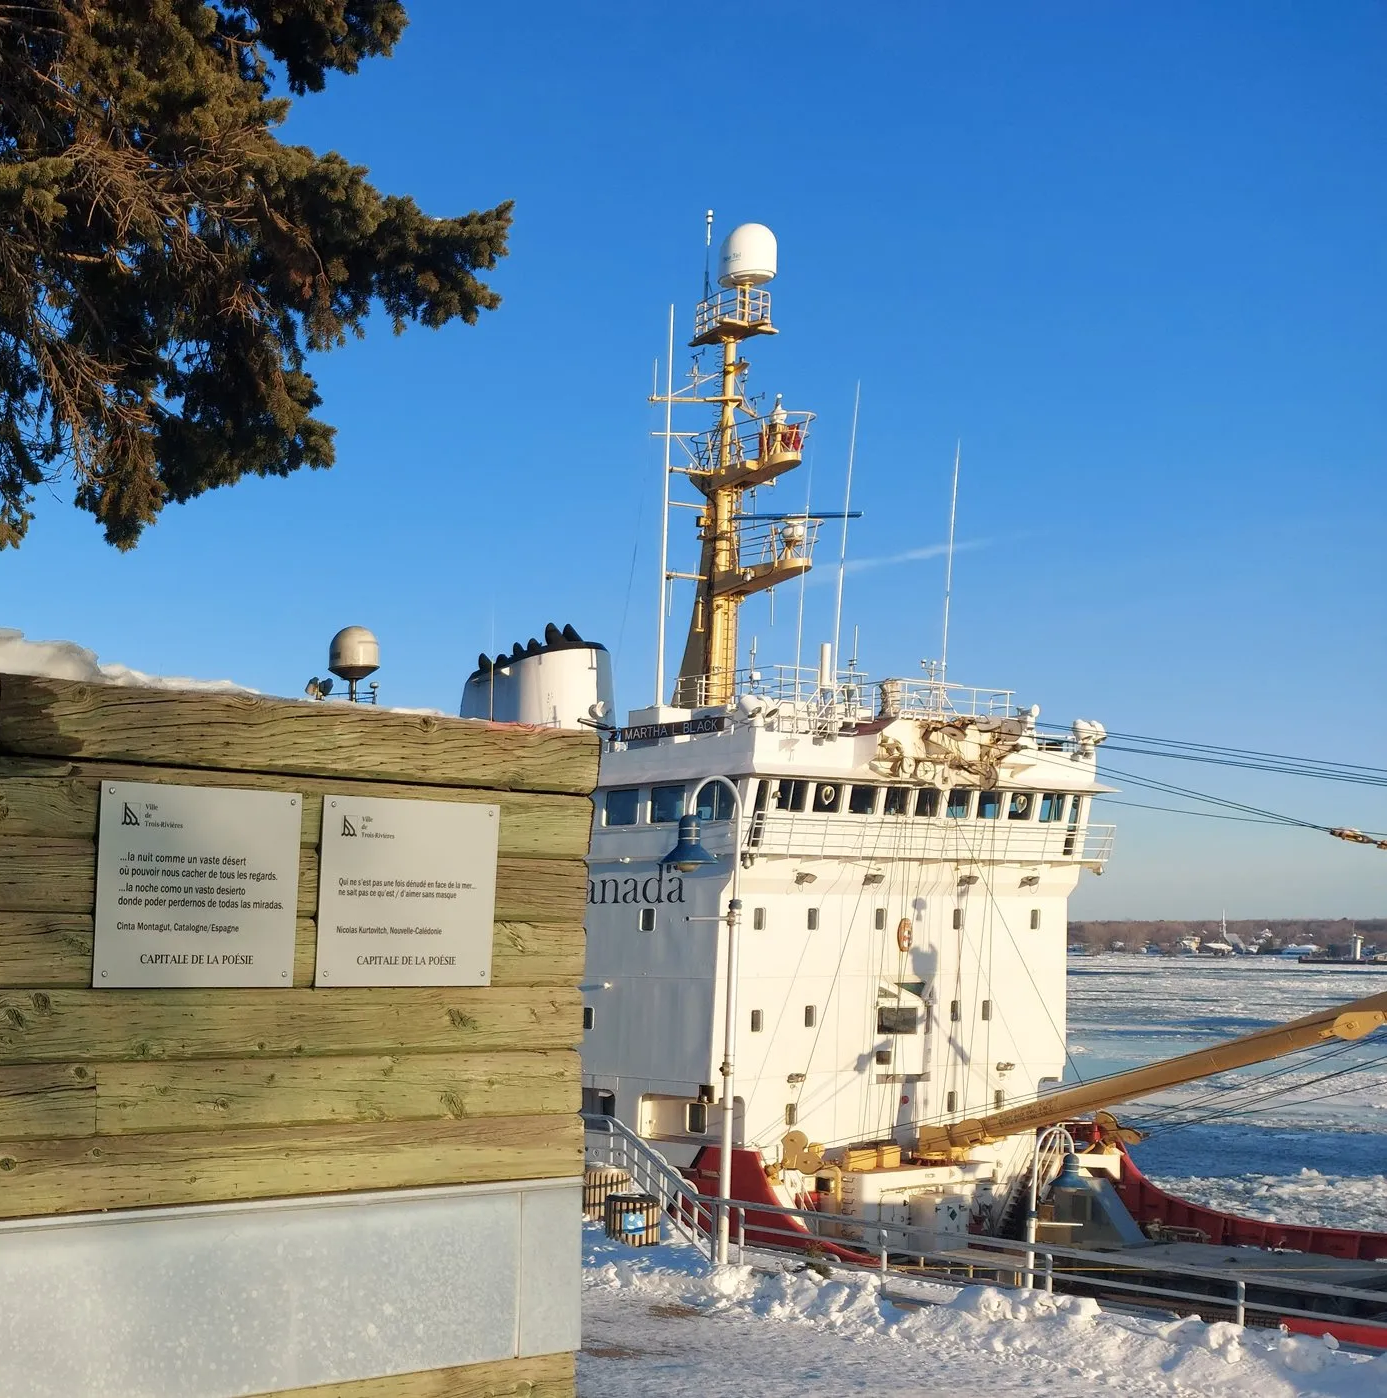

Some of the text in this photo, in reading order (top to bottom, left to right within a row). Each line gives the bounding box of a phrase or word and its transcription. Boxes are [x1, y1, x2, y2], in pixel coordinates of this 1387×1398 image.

[625, 719, 718, 740] MARTHA L BLACK
[137, 852, 153, 861] nuit
[155, 854, 185, 863] comme
[199, 855, 220, 865] vaste
[221, 855, 246, 866] désert
[119, 865, 277, 883] où pouvoir nous cacher de tous les regards.
[135, 882, 158, 892] noche
[160, 885, 181, 893] como
[194, 885, 214, 894] vasto
[216, 885, 245, 895] desierto
[586, 863, 685, 904] anada
[117, 895, 283, 909] donde poder perdernos de todas las miradas.
[116, 921, 239, 934] Cinta Montagut, Catalogne/Espagne
[336, 925, 357, 933] Nicolas
[389, 926, 442, 935] Nouvelle-Calédonie
[139, 952, 253, 964] CAPITALE DE LA POÉSIE
[356, 954, 456, 965] CAPITALE DE LA POÉSIE
